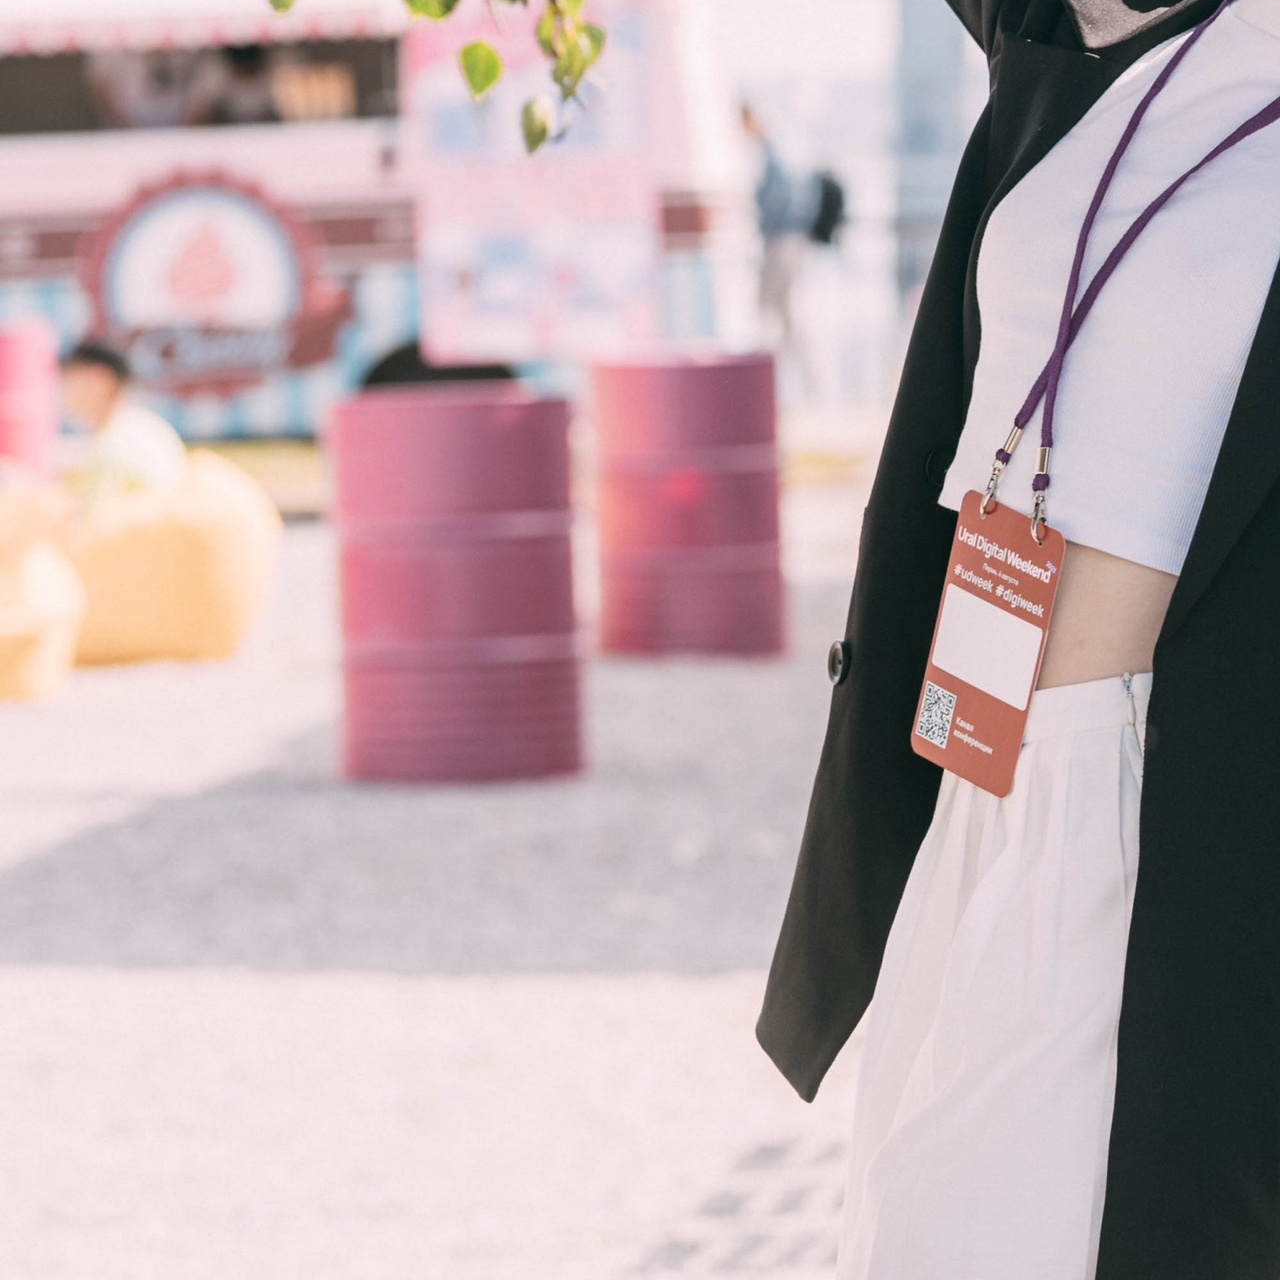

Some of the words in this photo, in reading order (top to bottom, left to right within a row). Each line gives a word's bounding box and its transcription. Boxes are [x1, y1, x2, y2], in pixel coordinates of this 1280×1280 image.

[957, 525, 978, 548] Ural
[975, 535, 1008, 562] Digital
[1006, 549, 1051, 584] Weekend
[953, 563, 994, 593] #udweek
[995, 584, 1045, 618] #digiweek
